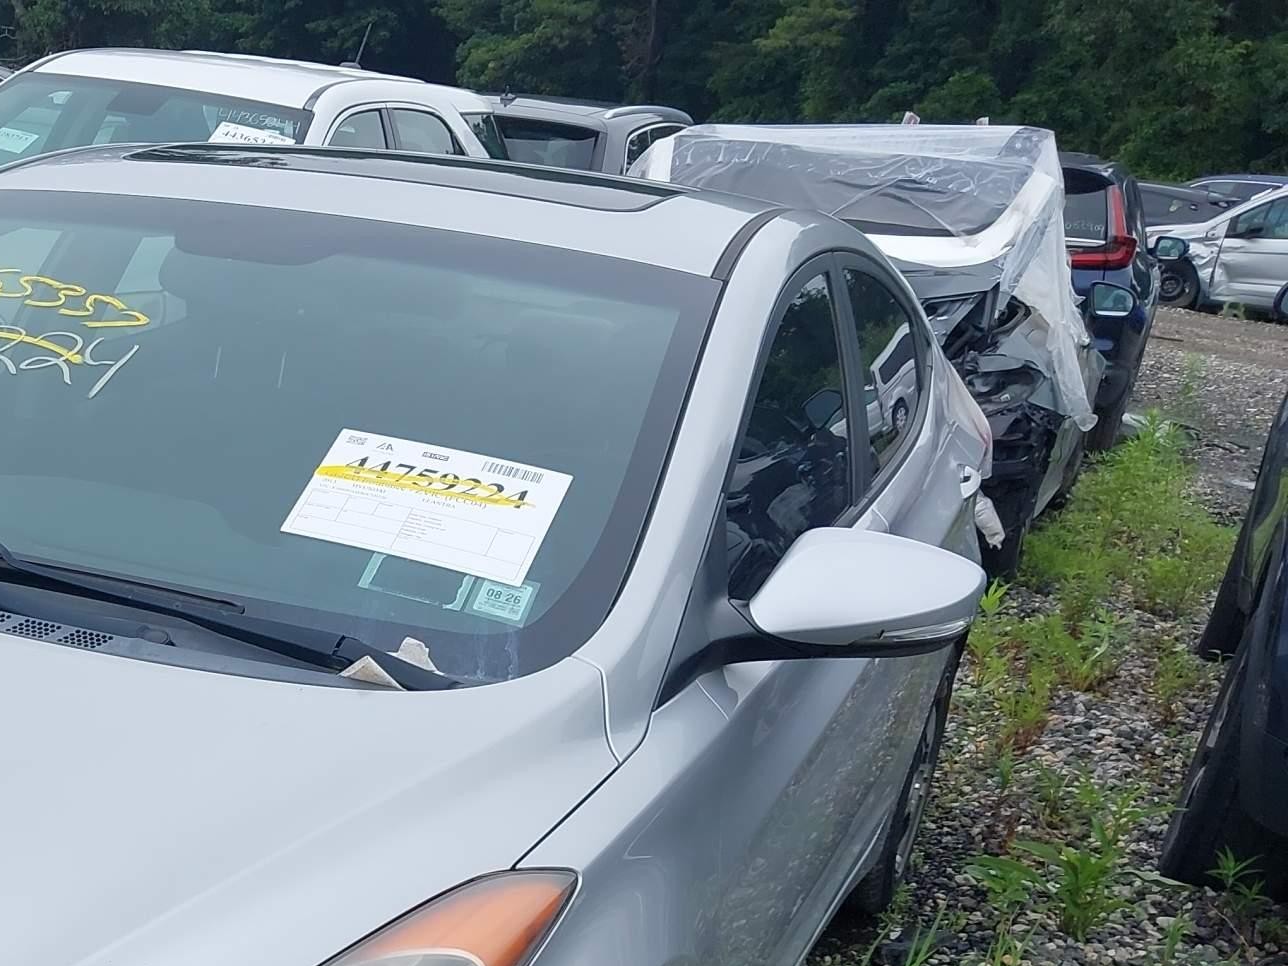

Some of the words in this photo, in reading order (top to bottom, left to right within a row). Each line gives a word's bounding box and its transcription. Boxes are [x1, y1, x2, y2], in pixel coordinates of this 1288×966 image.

[345, 456, 530, 509] 44759224
[486, 588, 503, 600] 08
[505, 592, 522, 605] 26
